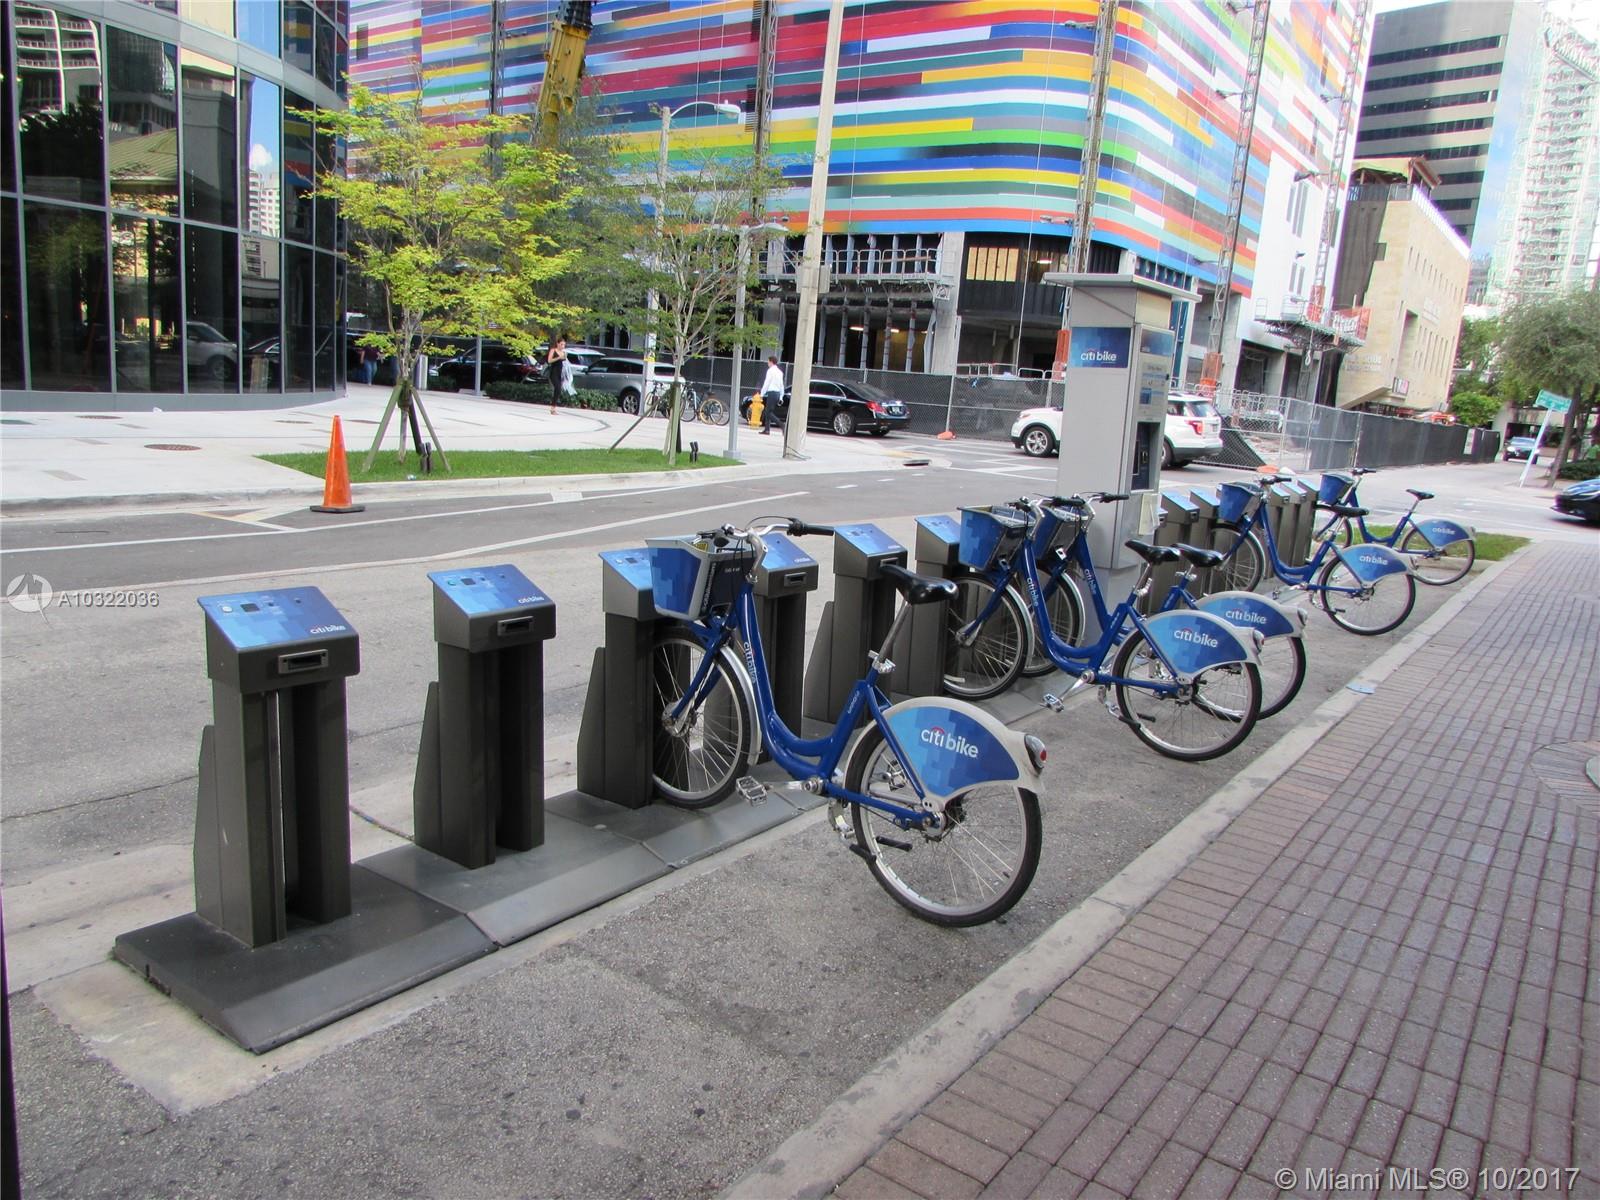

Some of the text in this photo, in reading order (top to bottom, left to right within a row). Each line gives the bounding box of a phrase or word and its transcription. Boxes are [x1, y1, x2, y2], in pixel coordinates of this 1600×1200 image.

[1080, 349, 1117, 361] citi bike
[1372, 555, 1389, 566] bike
[1225, 608, 1268, 625] citi bike
[1173, 627, 1219, 648] citi bike
[920, 726, 979, 759] citi bike
